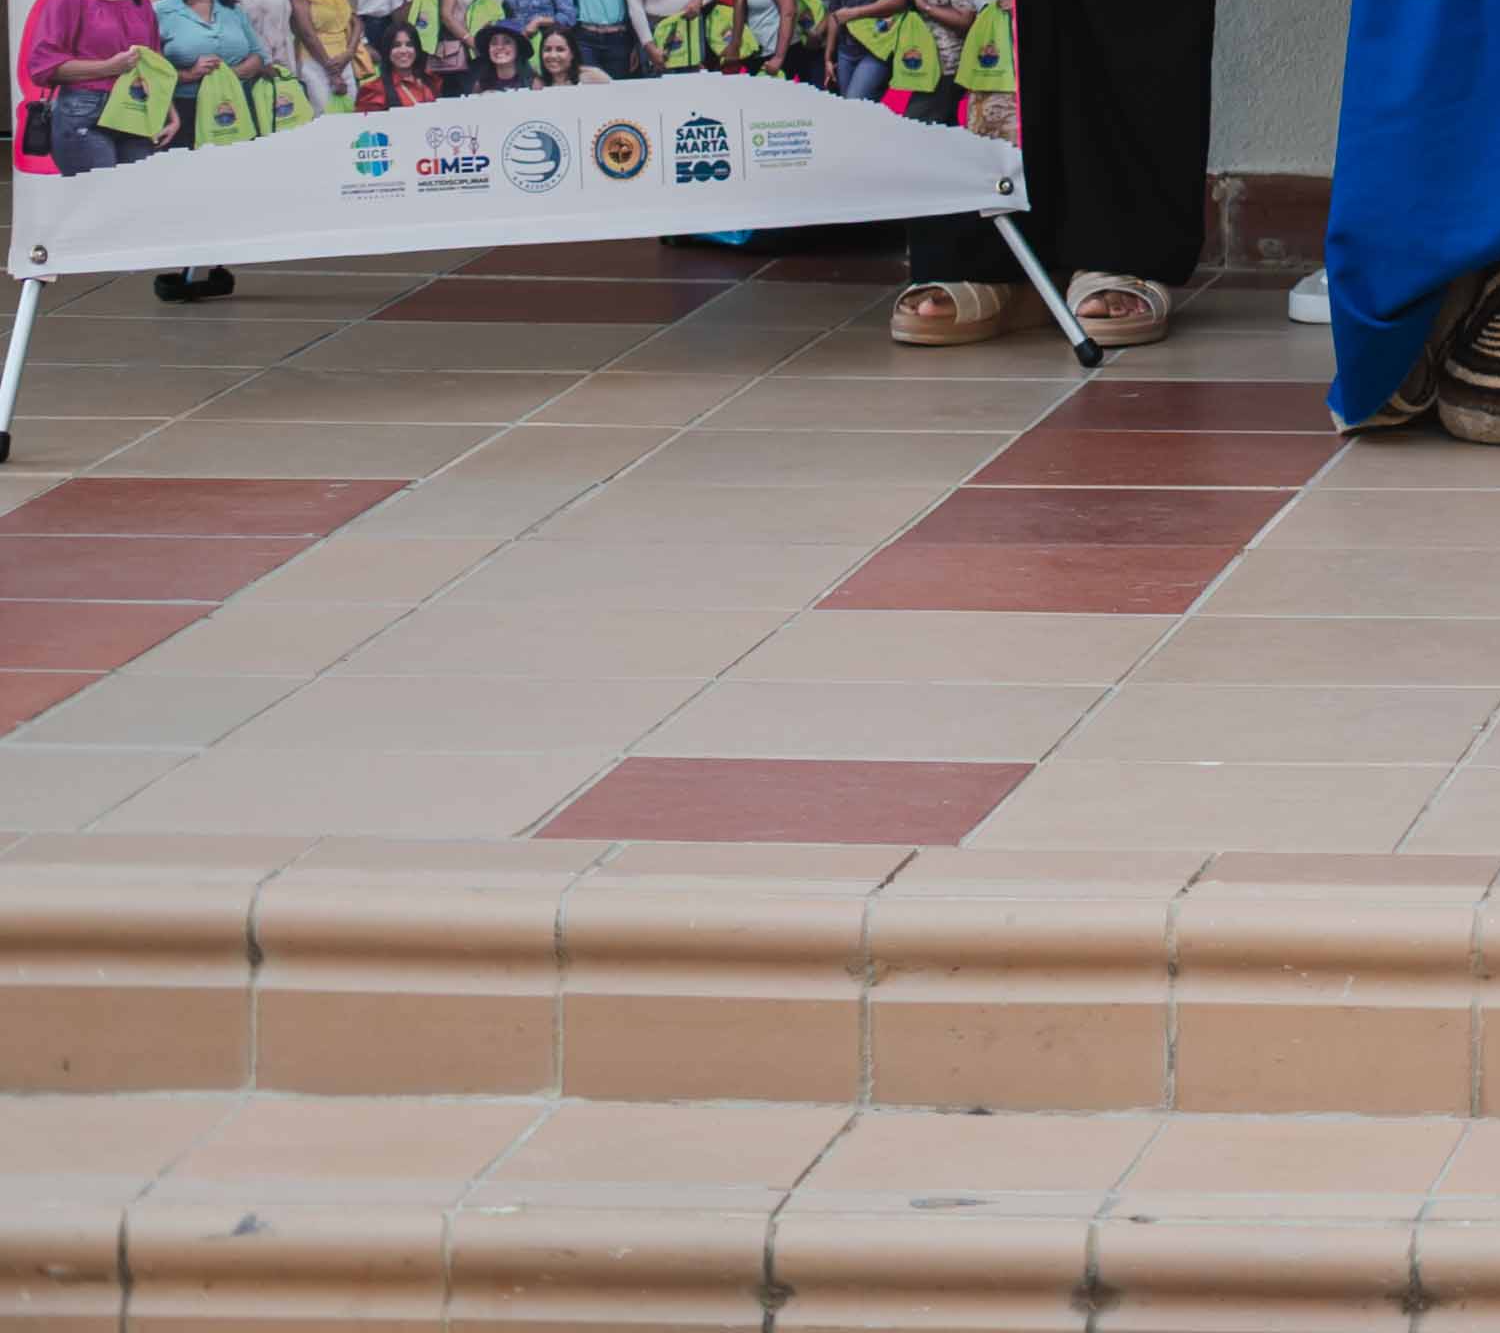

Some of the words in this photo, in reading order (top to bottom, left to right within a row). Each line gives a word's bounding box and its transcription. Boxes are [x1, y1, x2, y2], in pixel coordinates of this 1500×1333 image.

[676, 127, 728, 140] SANTA
[675, 140, 729, 154] MARTA
[416, 156, 490, 176] GIMEP
